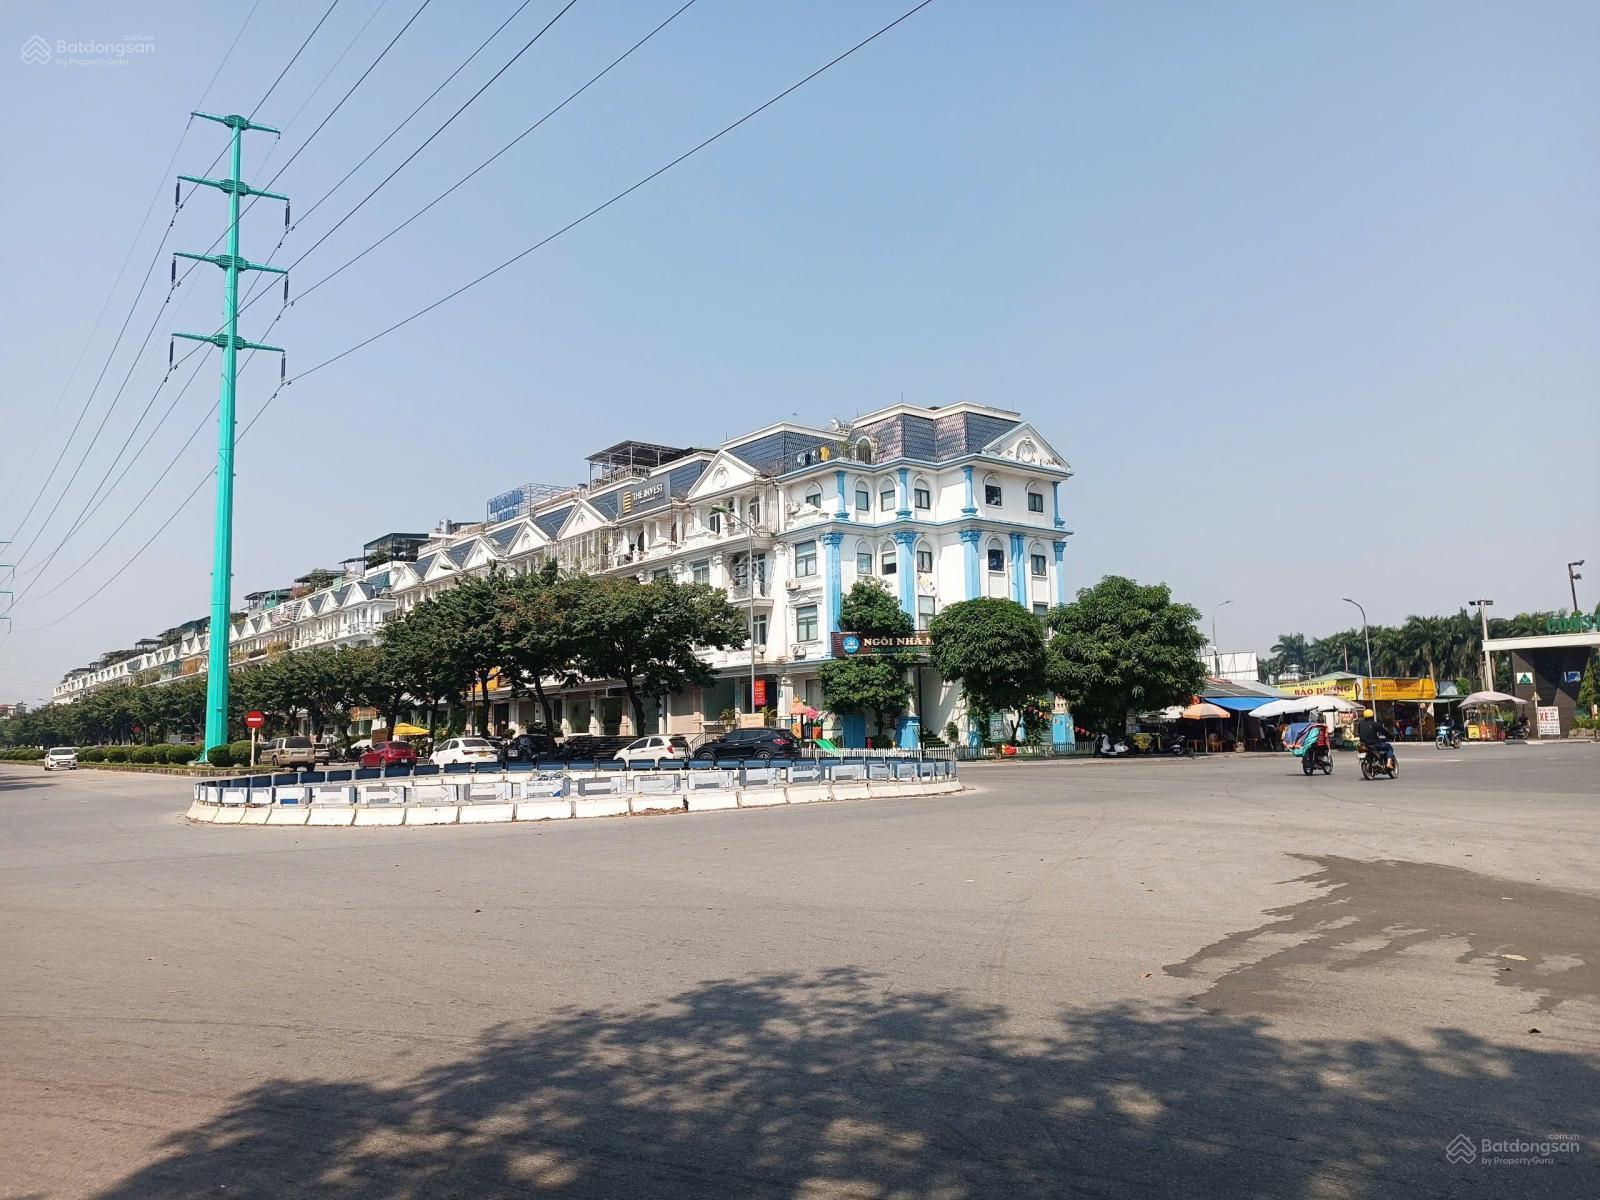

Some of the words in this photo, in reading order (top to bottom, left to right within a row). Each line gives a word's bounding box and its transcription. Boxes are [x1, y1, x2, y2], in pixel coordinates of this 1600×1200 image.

[632, 490, 643, 501] THE
[643, 483, 664, 498] INVEST
[863, 636, 893, 646] NGÔI
[896, 635, 922, 646] NHÀ
[1539, 712, 1550, 722] XE
